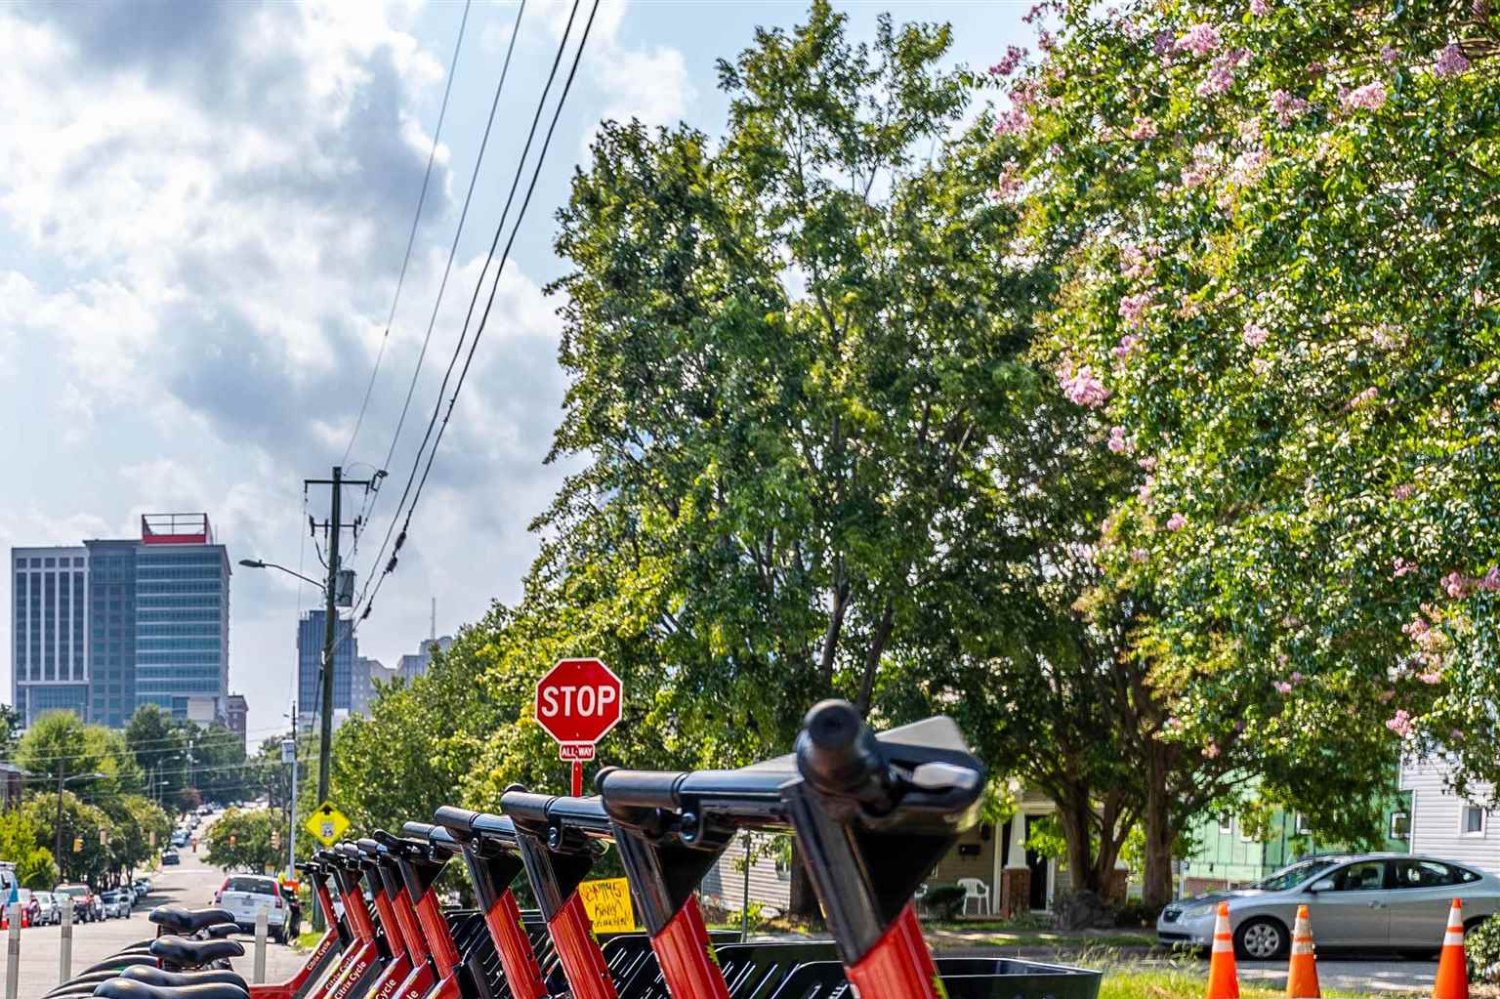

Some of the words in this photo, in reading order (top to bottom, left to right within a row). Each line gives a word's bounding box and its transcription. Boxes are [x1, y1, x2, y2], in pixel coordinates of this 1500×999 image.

[541, 685, 616, 717] STOP
[561, 747, 576, 757] ALL
[578, 747, 593, 757] WAY
[349, 961, 367, 981] Cycle
